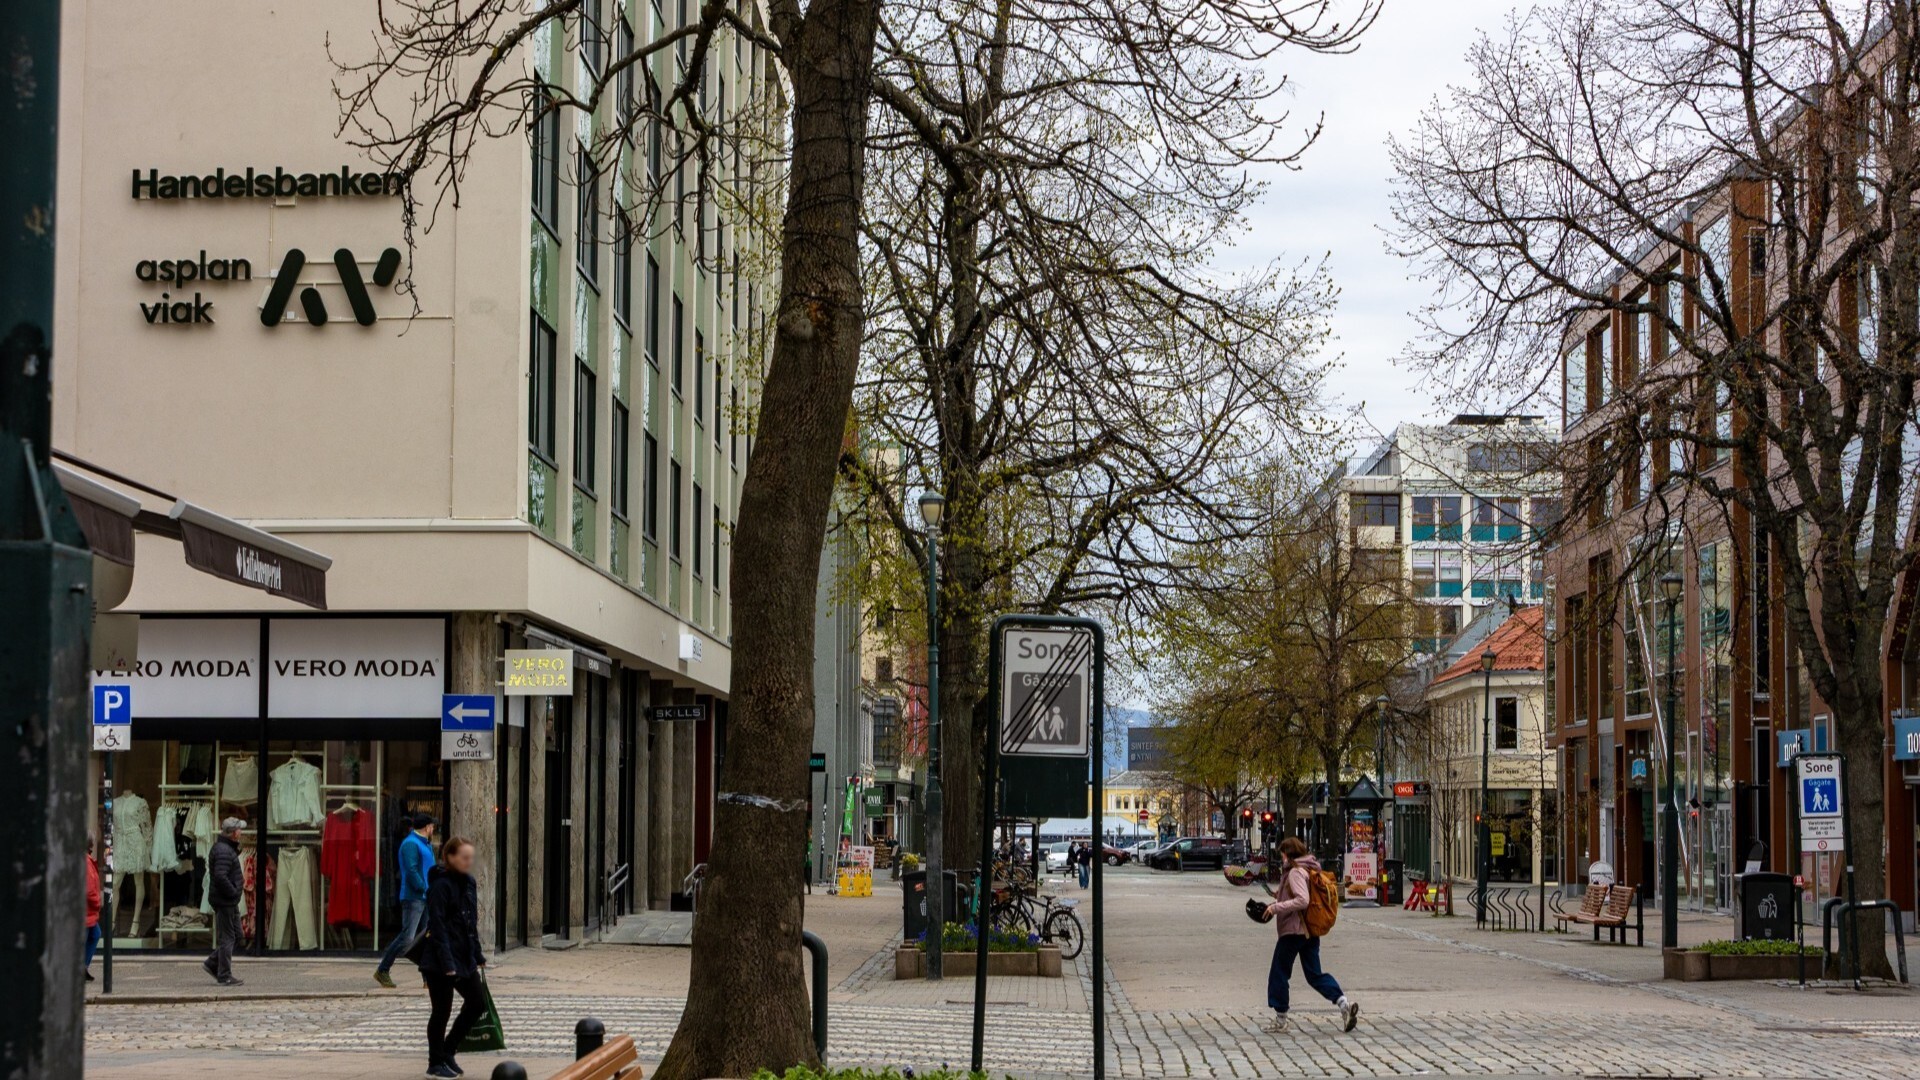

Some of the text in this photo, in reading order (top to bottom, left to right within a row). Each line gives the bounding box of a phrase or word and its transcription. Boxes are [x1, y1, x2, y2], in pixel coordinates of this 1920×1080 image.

[132, 165, 401, 199] Handelsbanken
[135, 250, 252, 289] asplan
[140, 293, 215, 324] viak
[1017, 637, 1077, 660] Sone
[170, 660, 251, 677] MODA
[274, 659, 436, 677] VERO MODA
[512, 657, 566, 672] VERO
[508, 673, 568, 688] MODA
[104, 690, 124, 720] P
[452, 749, 482, 759] unntatt
[1805, 762, 1834, 774] Sone
